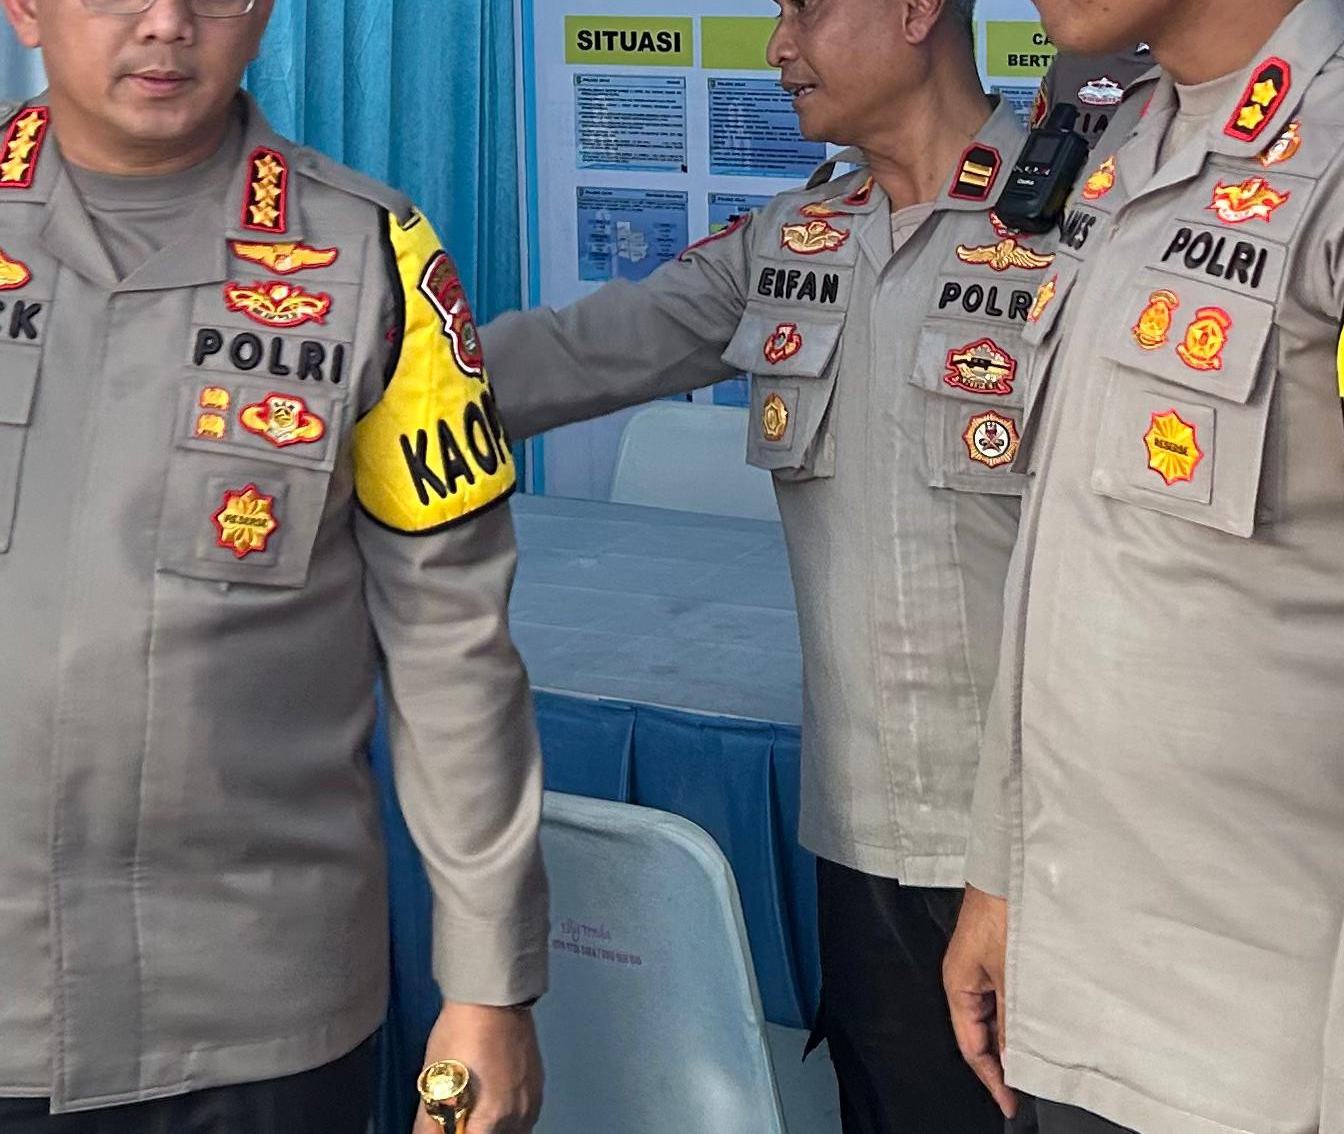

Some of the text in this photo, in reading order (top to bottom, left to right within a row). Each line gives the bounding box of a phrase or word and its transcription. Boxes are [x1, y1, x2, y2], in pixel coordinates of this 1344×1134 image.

[576, 29, 681, 54] SITUASI
[1008, 54, 1053, 67] BERT
[1161, 227, 1268, 288] POLRI
[939, 282, 1033, 321] POLR
[193, 328, 345, 384] POLRI
